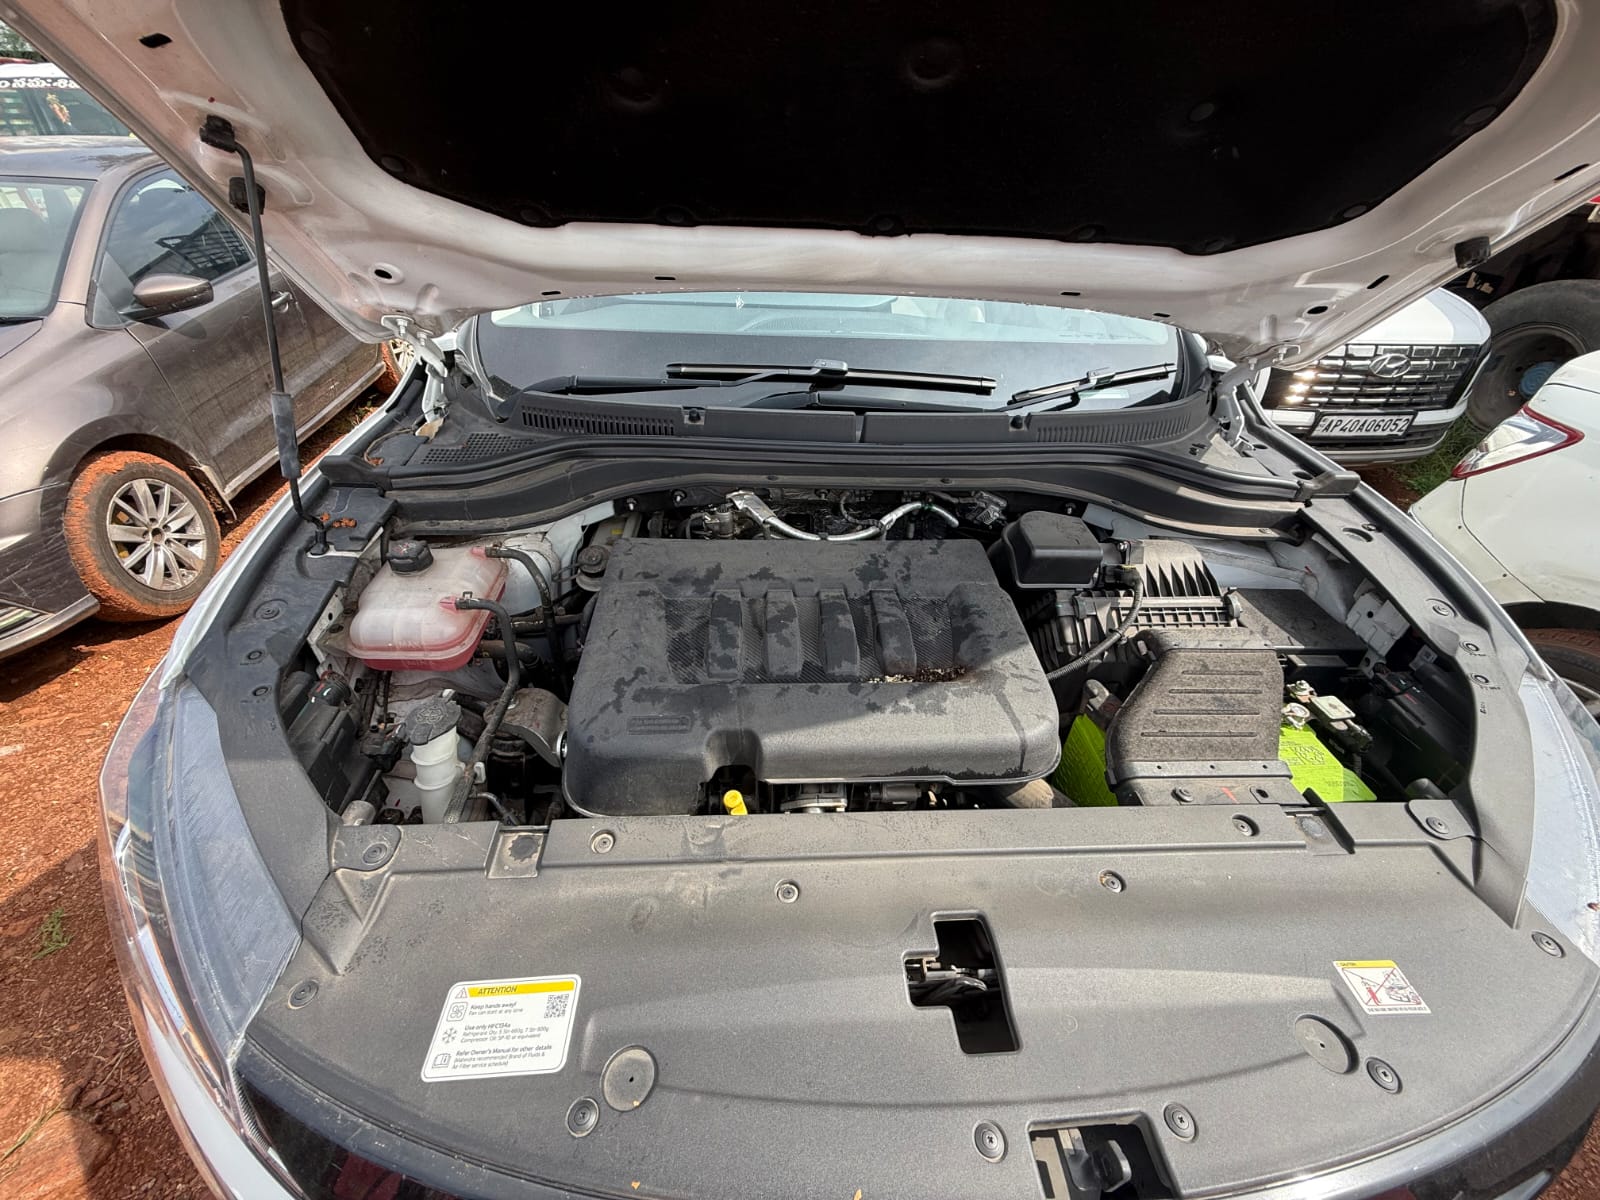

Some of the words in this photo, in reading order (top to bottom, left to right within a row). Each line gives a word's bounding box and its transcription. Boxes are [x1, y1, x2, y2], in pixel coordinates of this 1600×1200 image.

[53, 78, 80, 88] శివ
[1322, 418, 1409, 433] AP40AQ6052
[478, 985, 518, 995] ATTENTION
[475, 1024, 487, 1032] only
[488, 1022, 511, 1030] HFC134a
